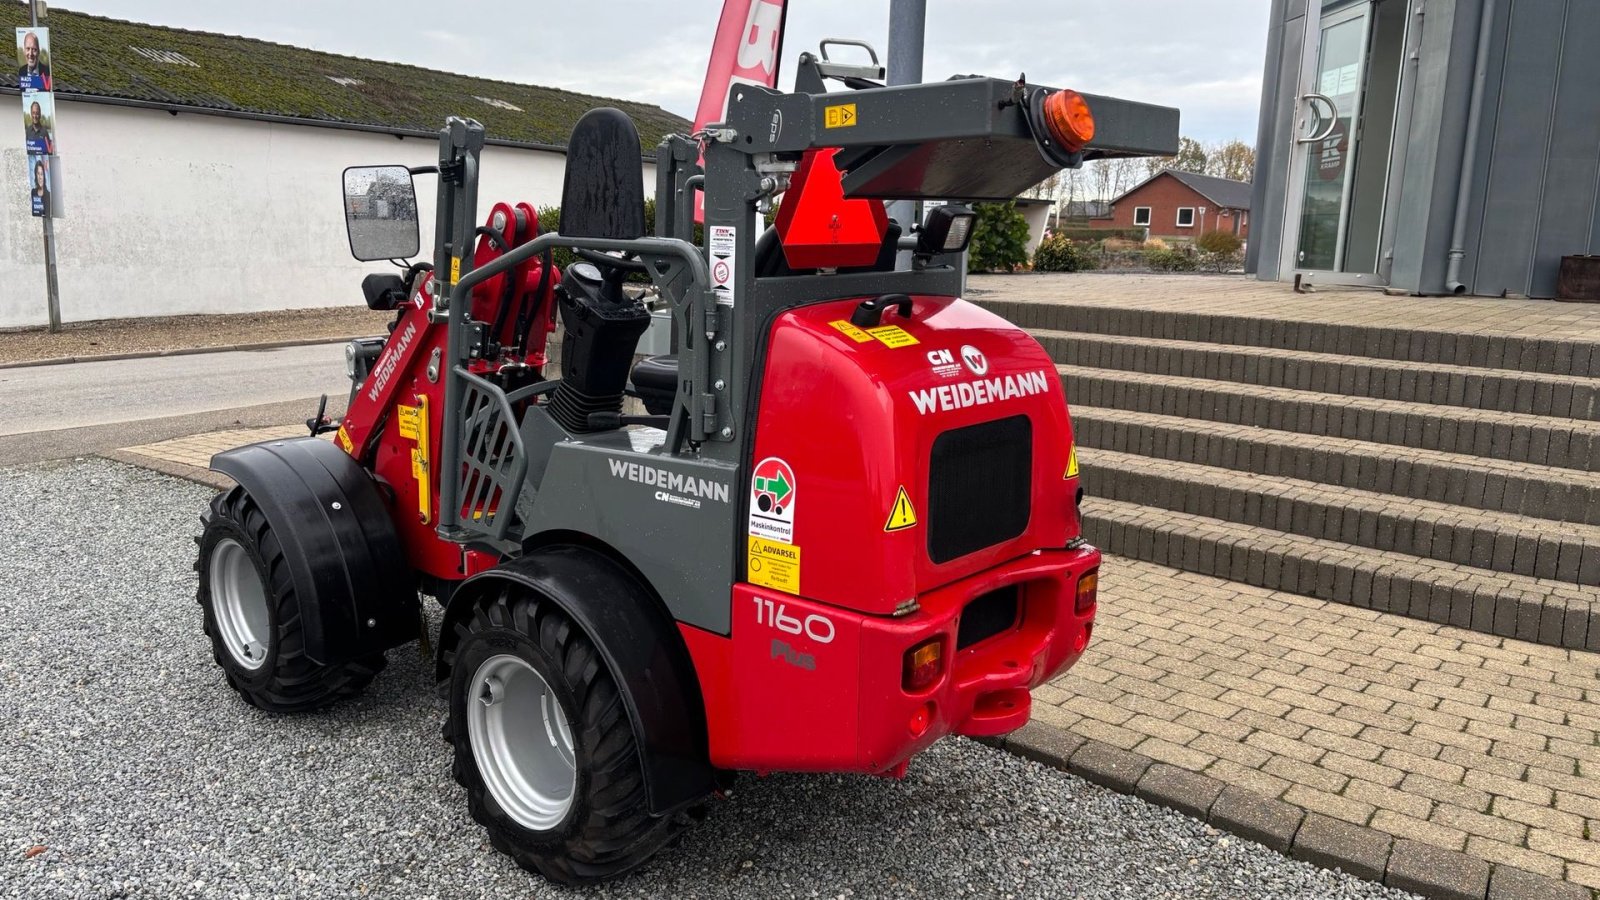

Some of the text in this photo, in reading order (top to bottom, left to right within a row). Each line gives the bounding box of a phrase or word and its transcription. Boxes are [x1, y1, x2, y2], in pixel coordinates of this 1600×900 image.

[368, 321, 417, 402] WEIDEMANN
[927, 349, 954, 365] CN
[908, 370, 1049, 415] WEIDEMANN
[608, 458, 729, 503] WEIDEMANN
[655, 491, 670, 502] CN
[751, 520, 791, 535] Maskinkontrol
[763, 545, 797, 560] ADVARSEL
[753, 596, 836, 643] 1160
[771, 638, 817, 671] Plus
